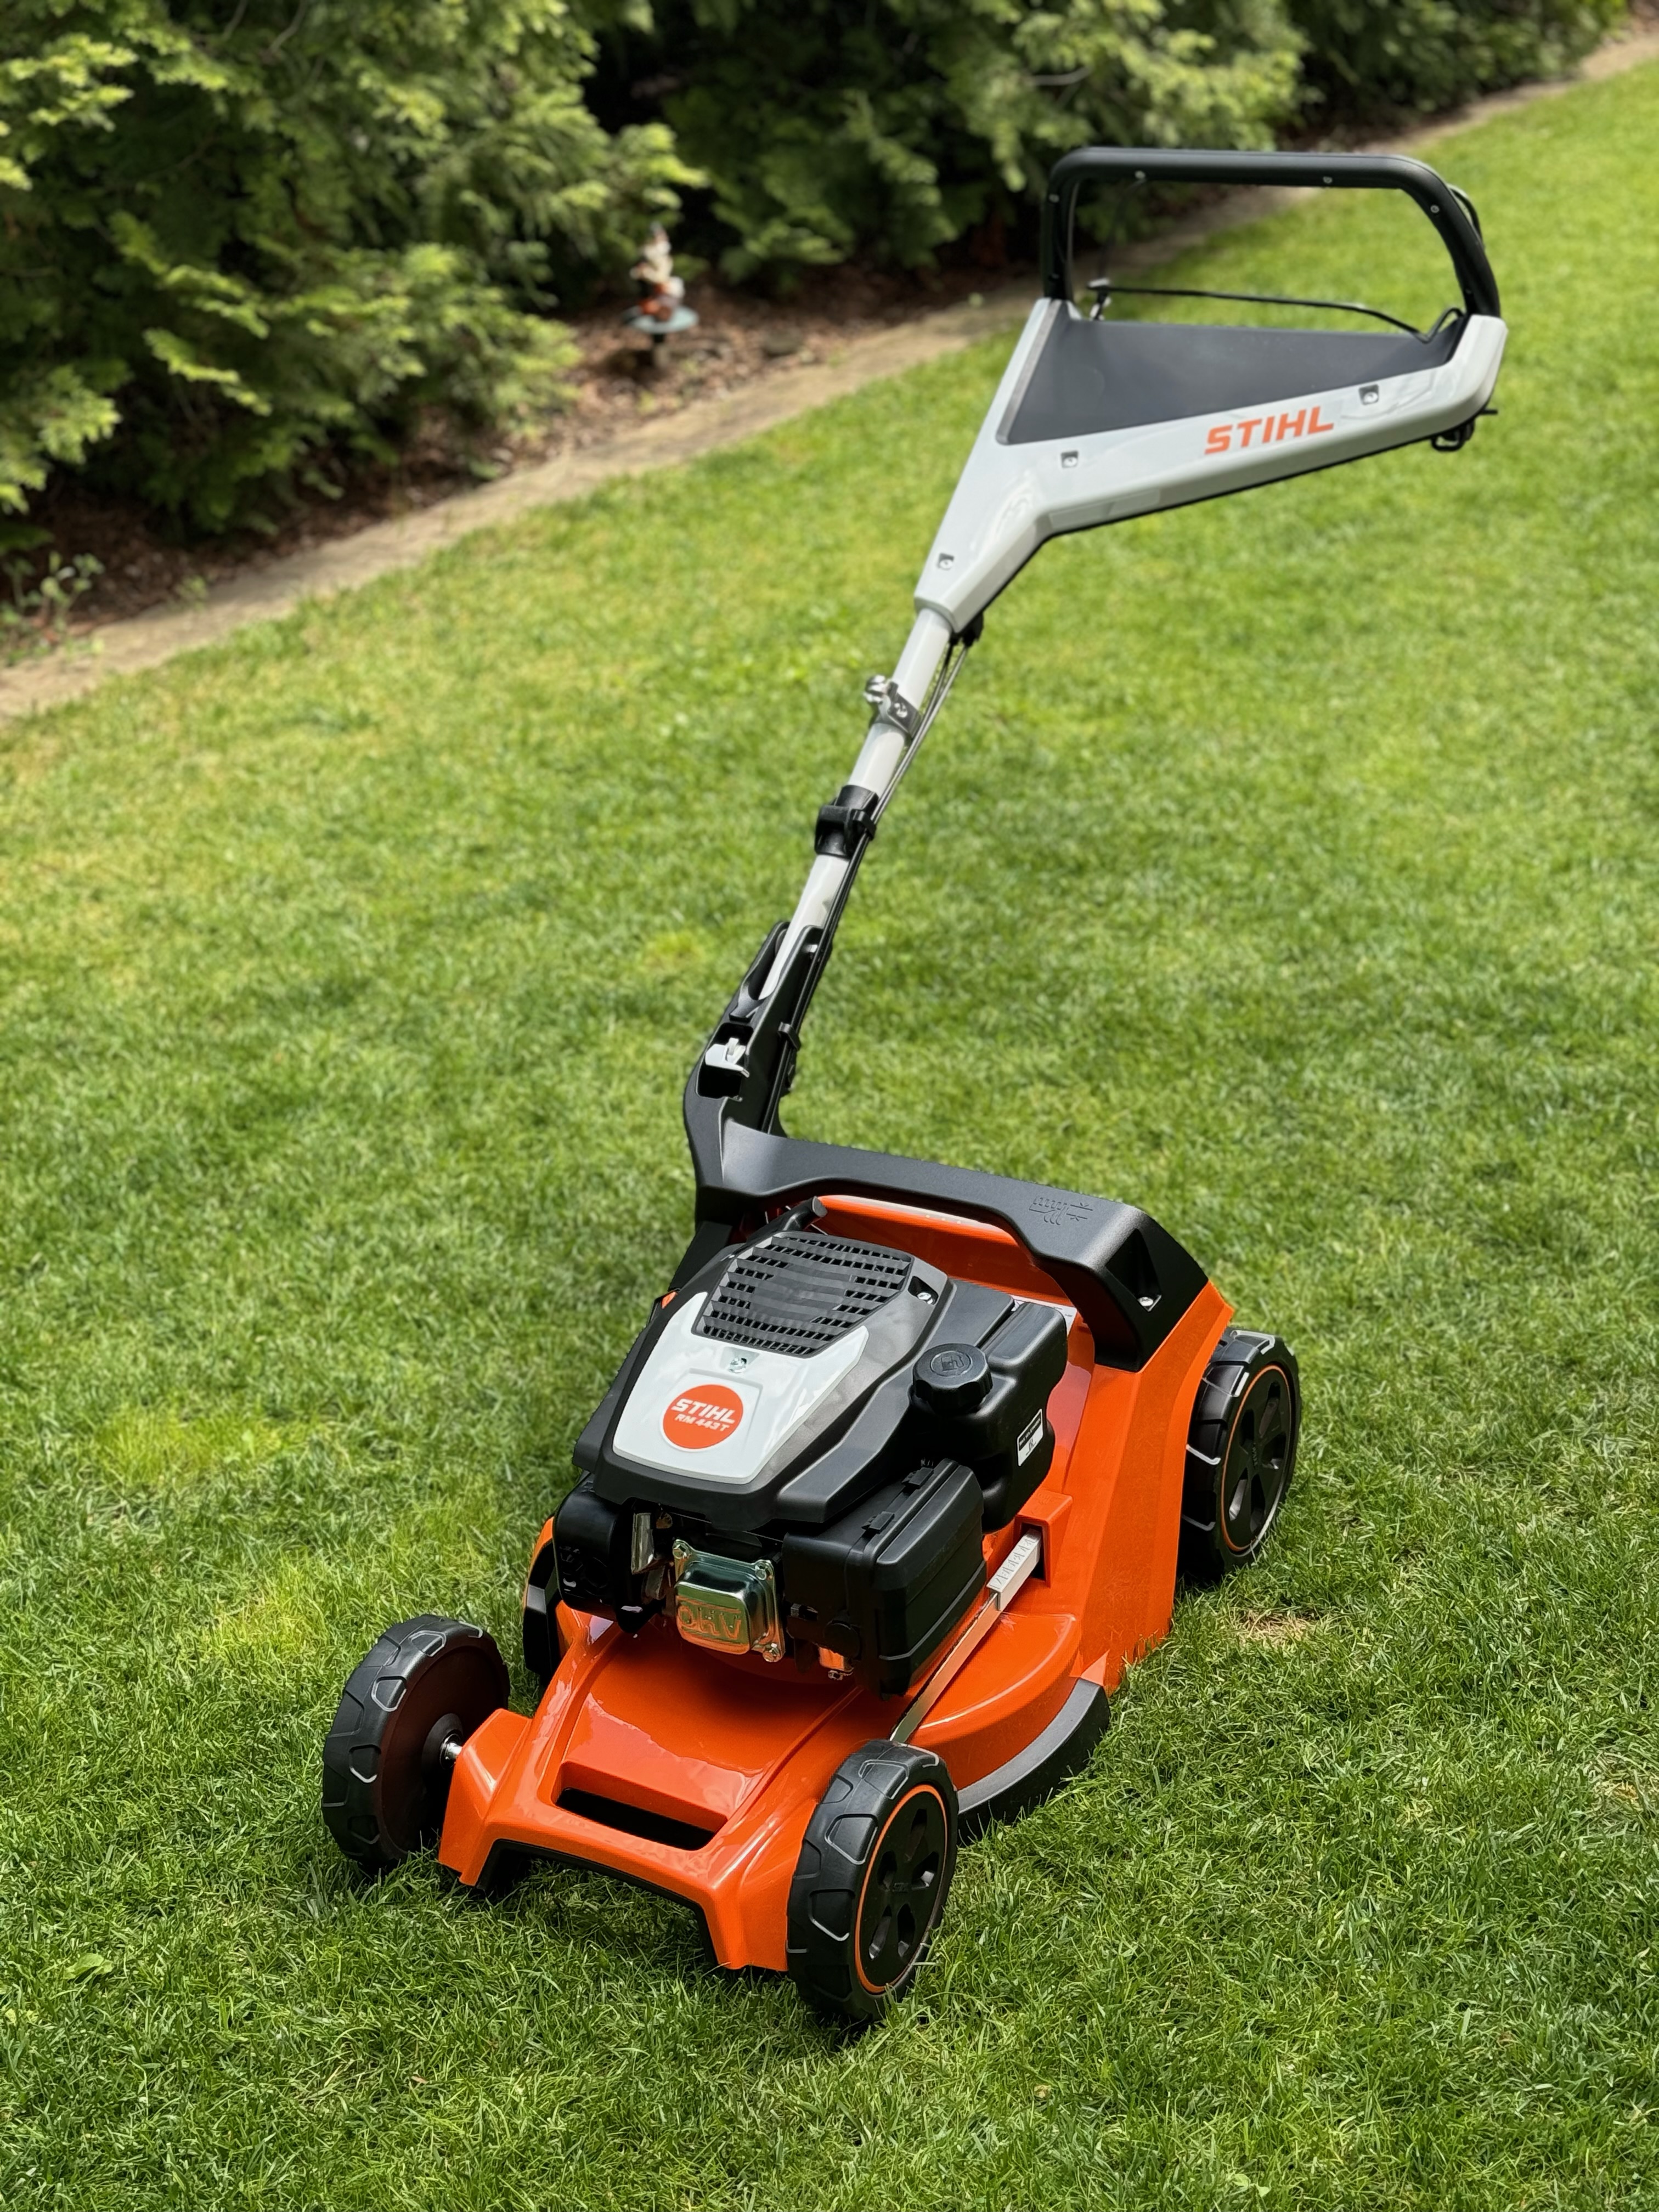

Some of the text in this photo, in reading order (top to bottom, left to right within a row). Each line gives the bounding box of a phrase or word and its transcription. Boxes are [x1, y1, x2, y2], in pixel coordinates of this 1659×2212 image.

[1204, 405, 1334, 455] STIHL
[672, 1398, 735, 1424] STIHL
[675, 1414, 695, 1424] RM
[696, 1419, 720, 1430] 443
[678, 1605, 742, 1639] OHV
